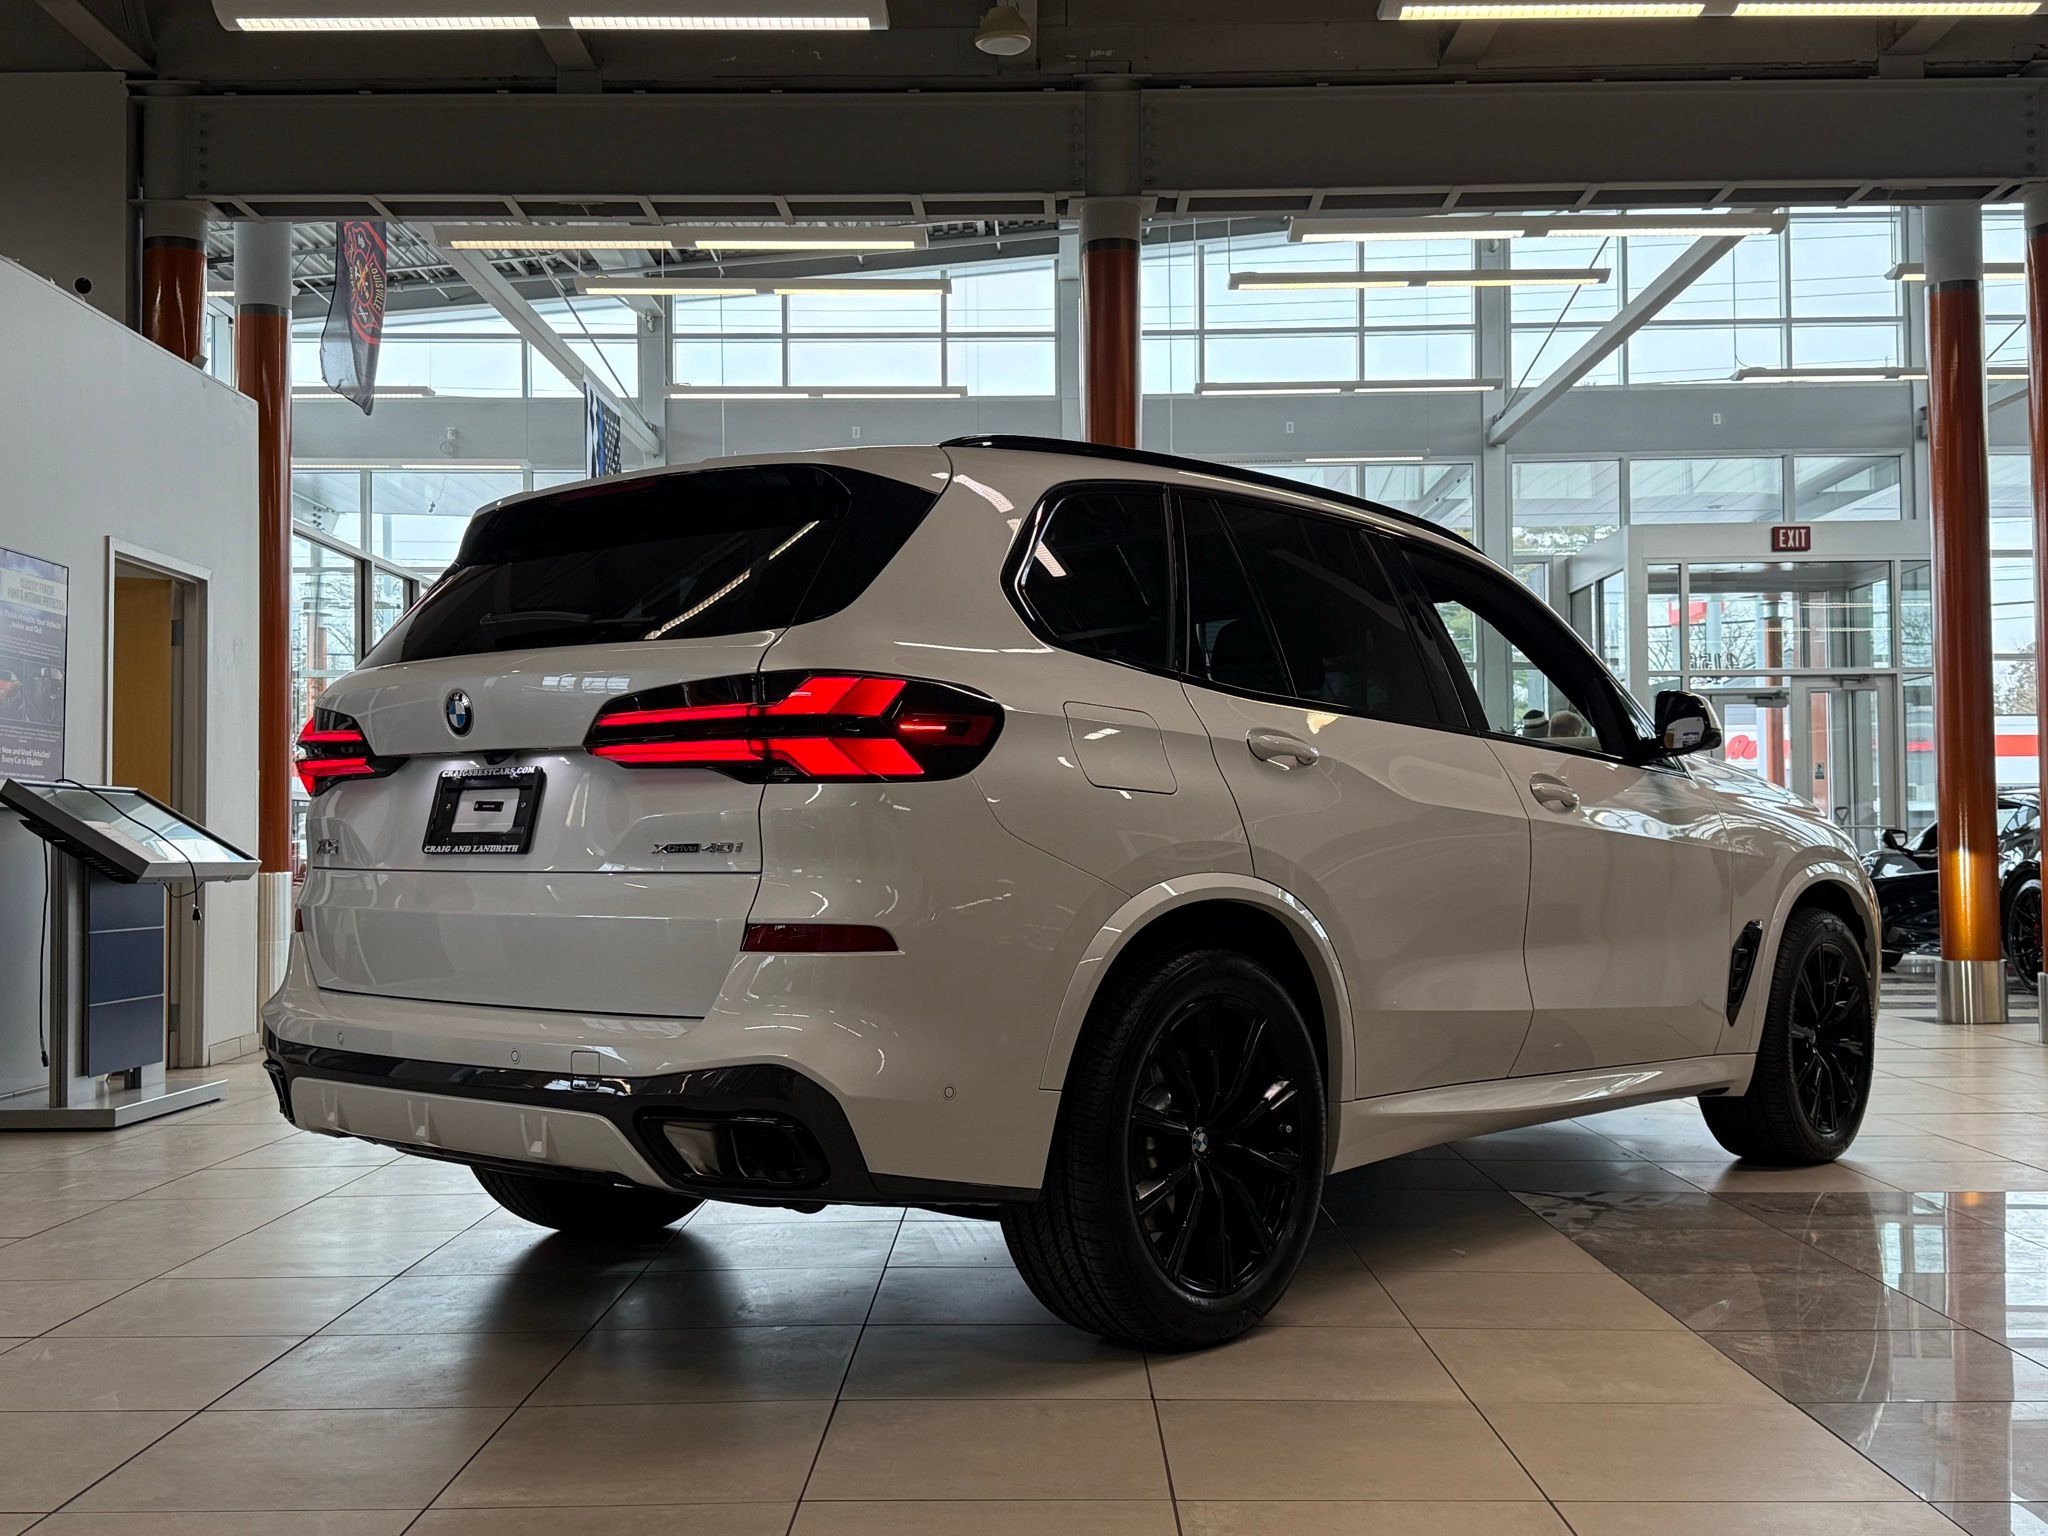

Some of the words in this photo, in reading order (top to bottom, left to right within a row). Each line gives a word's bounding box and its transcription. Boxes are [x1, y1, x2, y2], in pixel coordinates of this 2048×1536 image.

[370, 262, 384, 311] LOUISVILLE
[1780, 529, 1806, 547] EXIT
[424, 845, 451, 853] CRAIG
[452, 845, 471, 853] AND
[473, 844, 519, 853] LANDRETH
